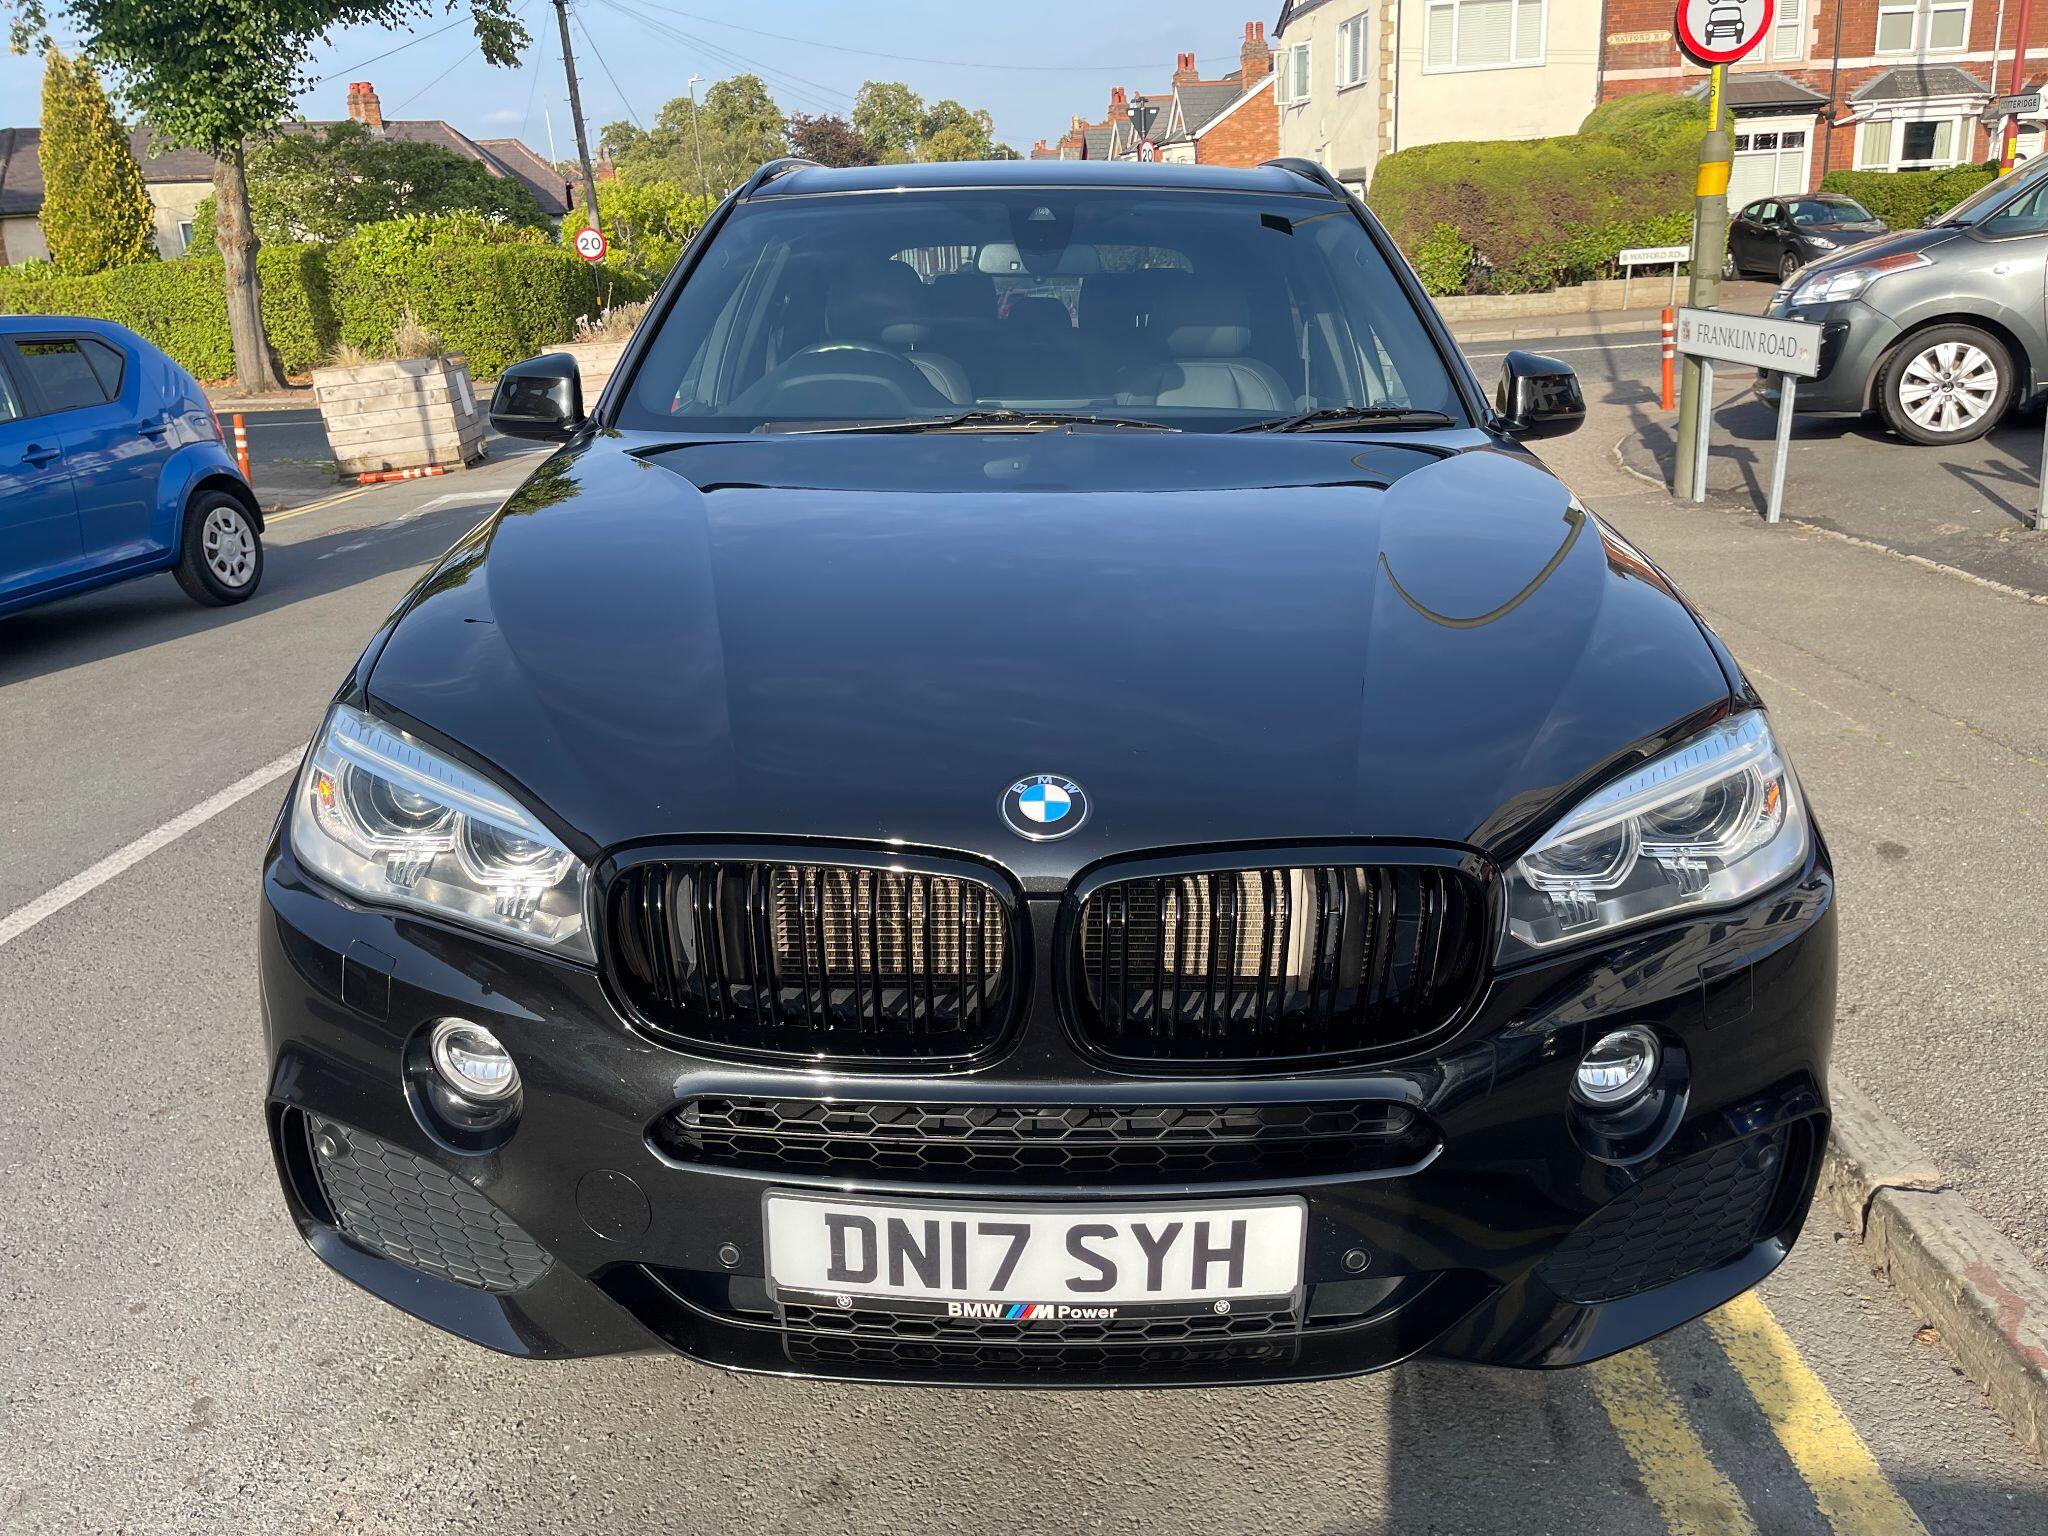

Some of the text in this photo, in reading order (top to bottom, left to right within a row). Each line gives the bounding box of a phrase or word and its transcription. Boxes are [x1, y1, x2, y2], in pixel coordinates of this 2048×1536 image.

[1142, 148, 1153, 162] 20
[580, 237, 601, 250] 20
[1630, 252, 1667, 260] WATFORD
[1697, 324, 1756, 351] FRANKLIN
[1759, 332, 1798, 357] ROAD
[1012, 775, 1080, 794] BMW
[825, 1213, 1247, 1293] DN17 SYH
[948, 1302, 1003, 1317] BMW
[1058, 1305, 1118, 1319] Power
